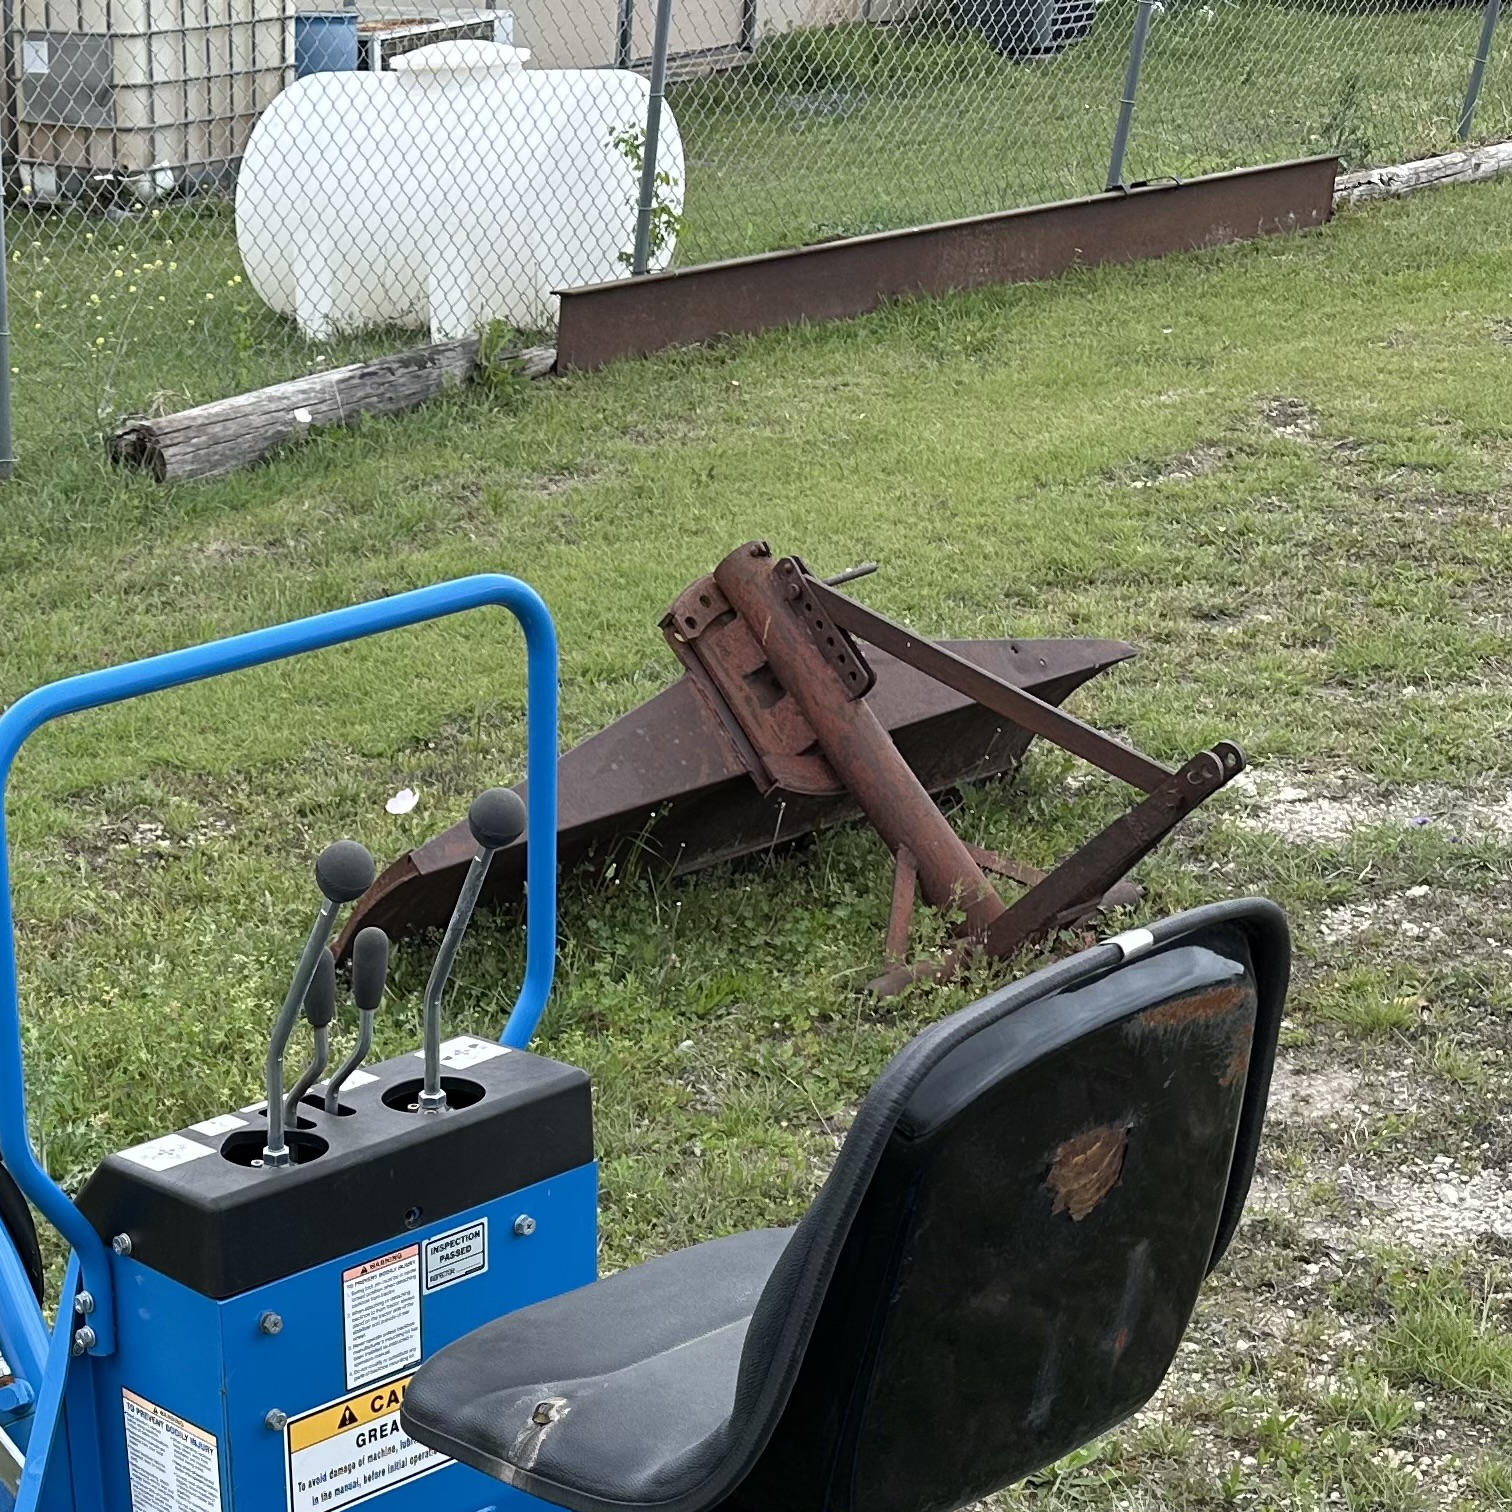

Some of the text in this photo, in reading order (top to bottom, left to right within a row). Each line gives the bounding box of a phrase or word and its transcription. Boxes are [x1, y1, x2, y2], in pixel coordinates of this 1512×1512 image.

[431, 1230, 481, 1255] INSPECTION
[439, 1245, 472, 1263] PASSED
[298, 1481, 306, 1493] To
[308, 1471, 327, 1489] avoid
[329, 1460, 356, 1480] damage
[358, 1455, 365, 1466] of
[368, 1444, 398, 1463] machine,
[321, 1490, 332, 1503] the
[335, 1477, 361, 1497] manual,
[364, 1469, 386, 1485] before
[388, 1457, 408, 1475] initial
